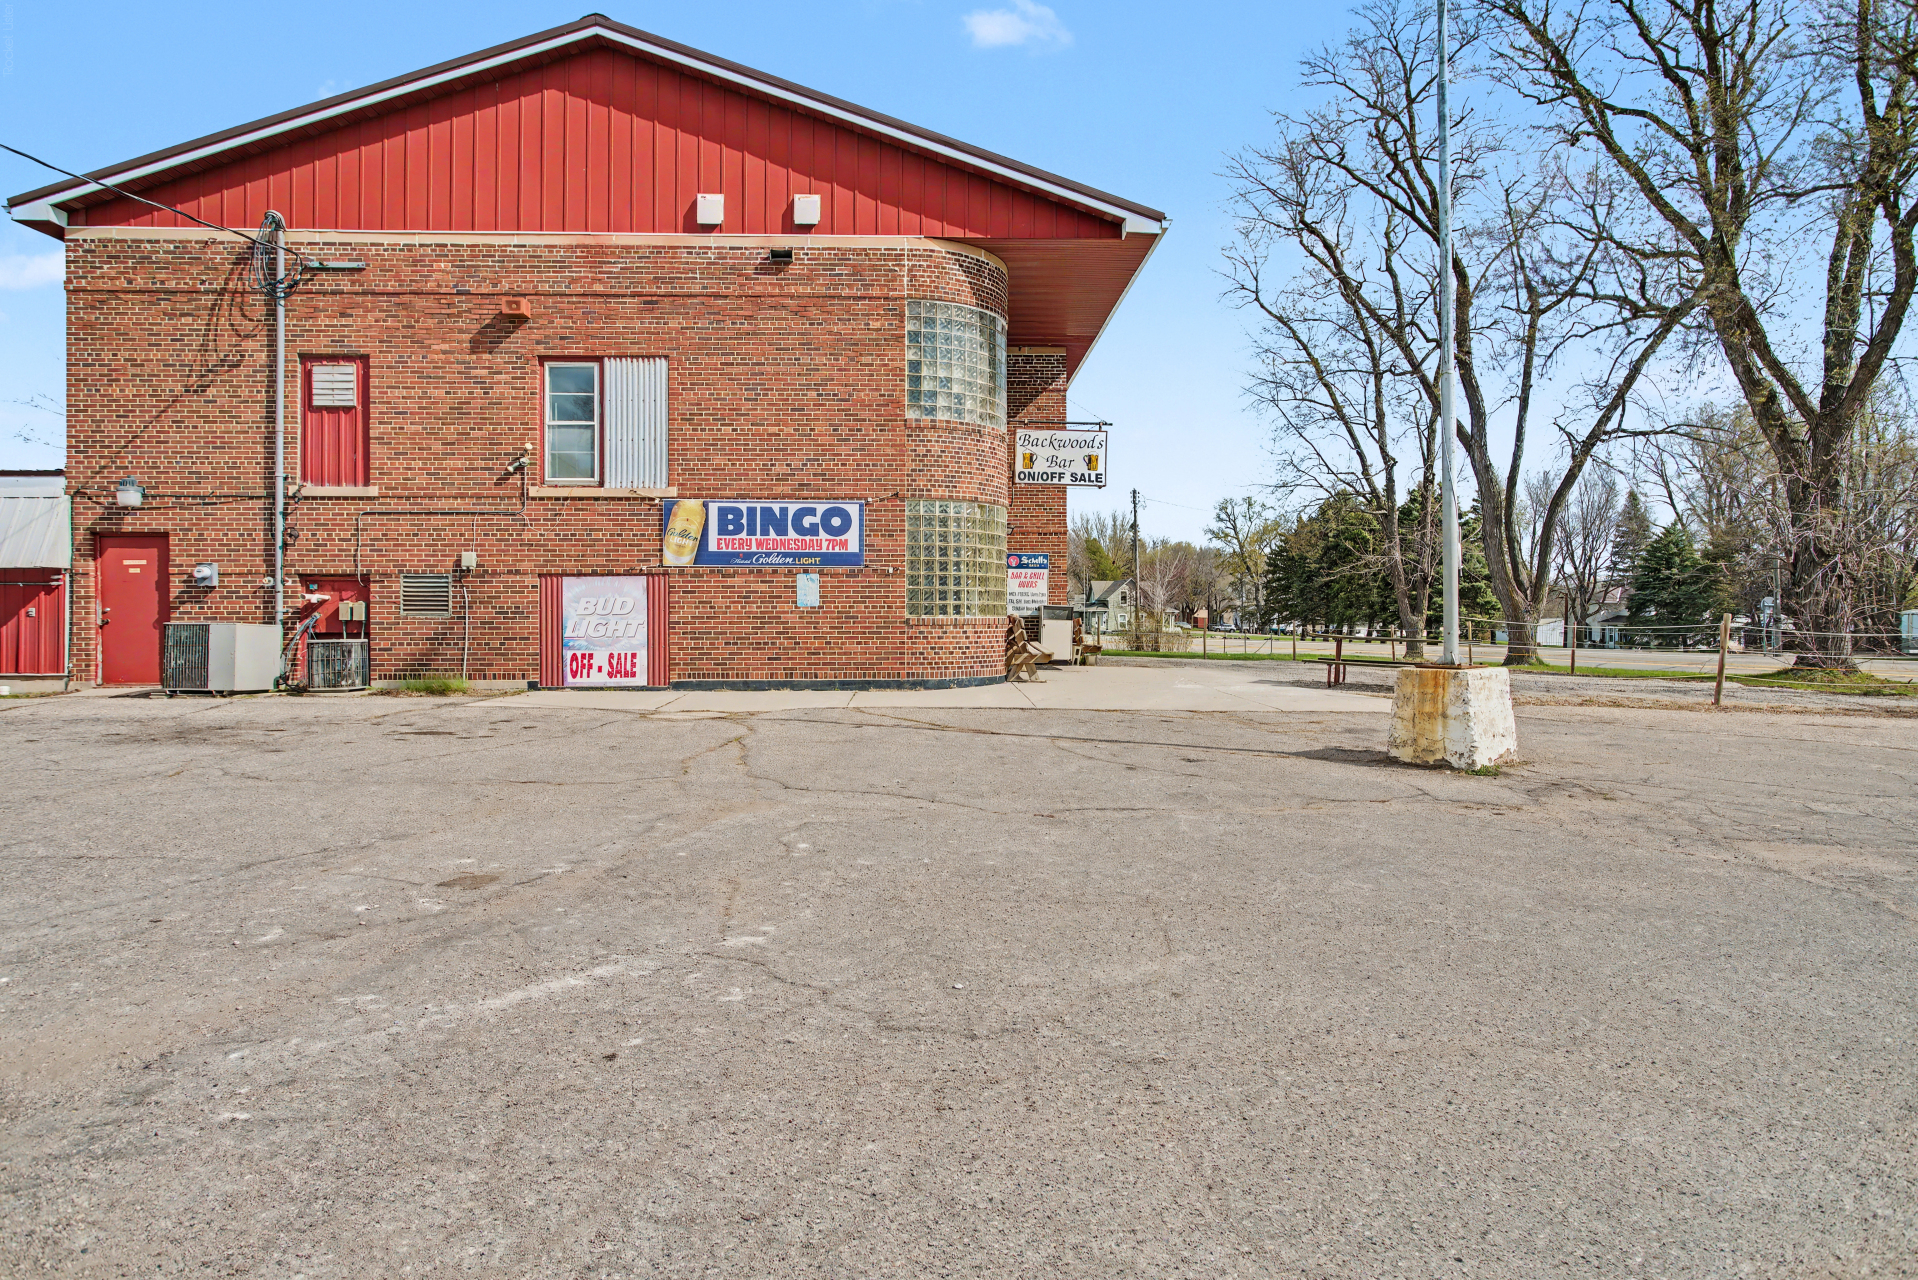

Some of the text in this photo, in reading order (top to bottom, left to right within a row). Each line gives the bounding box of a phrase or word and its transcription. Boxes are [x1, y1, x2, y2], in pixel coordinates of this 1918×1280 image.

[1018, 433, 1104, 451] Backwoods
[1046, 454, 1075, 469] Bar
[1017, 471, 1103, 483] ON/OFF SALE
[717, 506, 852, 537] BINGO
[667, 527, 698, 542] Golden
[716, 537, 849, 551] EVERY WEDNESDAY 7PM
[752, 553, 795, 564] Golden
[576, 597, 635, 616] BUD
[564, 619, 645, 639] LIGHT
[569, 652, 594, 679] OFF
[607, 652, 637, 679] SALE
